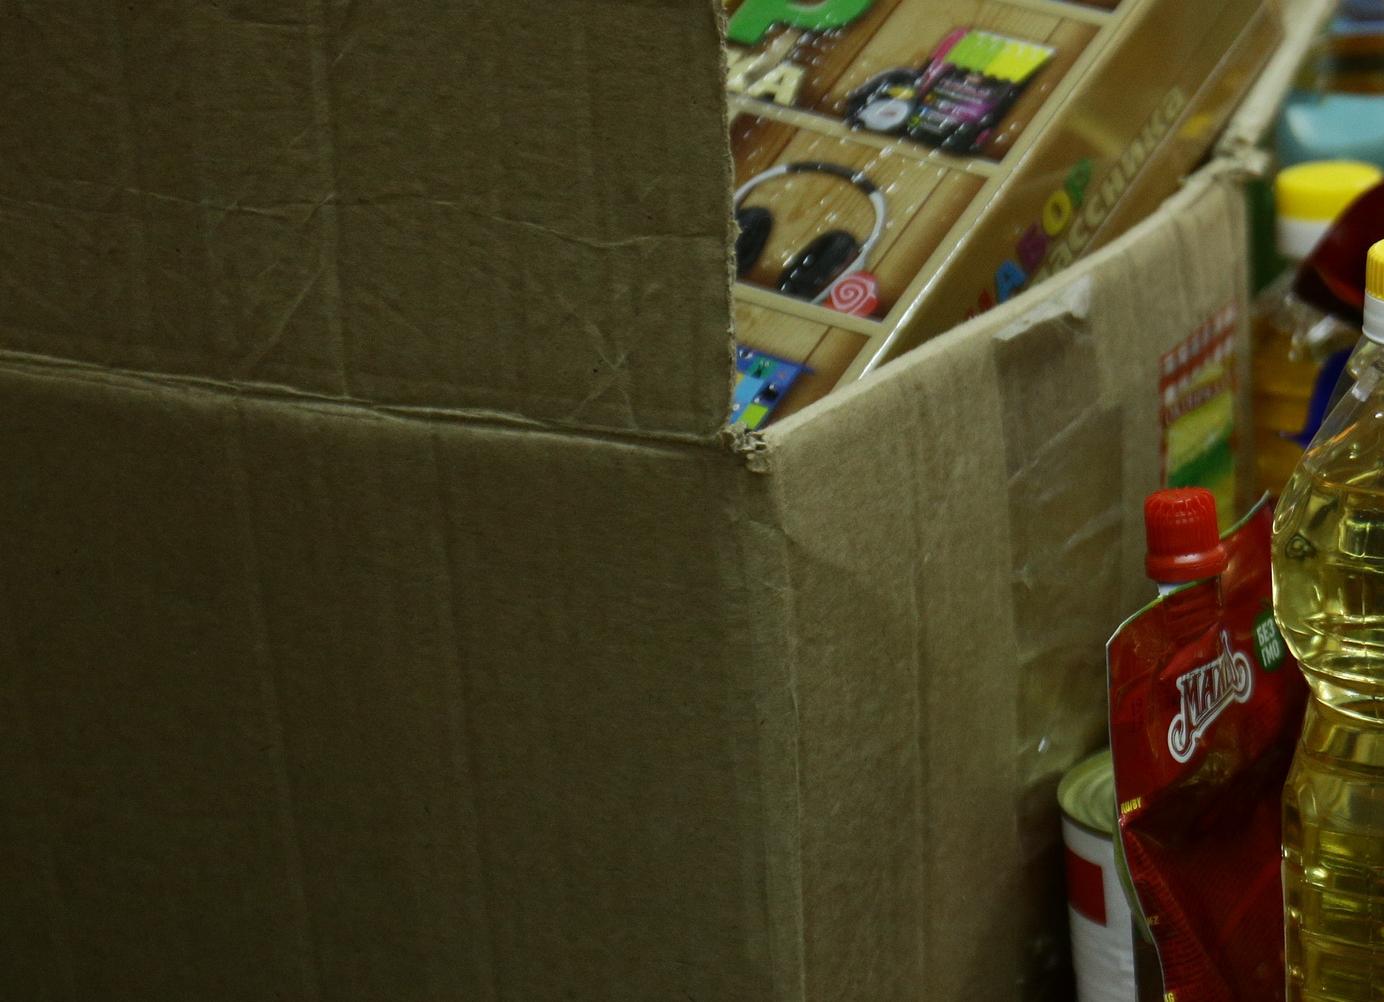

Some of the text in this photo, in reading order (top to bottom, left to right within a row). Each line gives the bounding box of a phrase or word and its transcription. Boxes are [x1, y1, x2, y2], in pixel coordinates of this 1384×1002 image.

[1033, 86, 1186, 284] ассника
[1256, 617, 1276, 645] БЕЗ
[1261, 641, 1281, 668] ГМО
